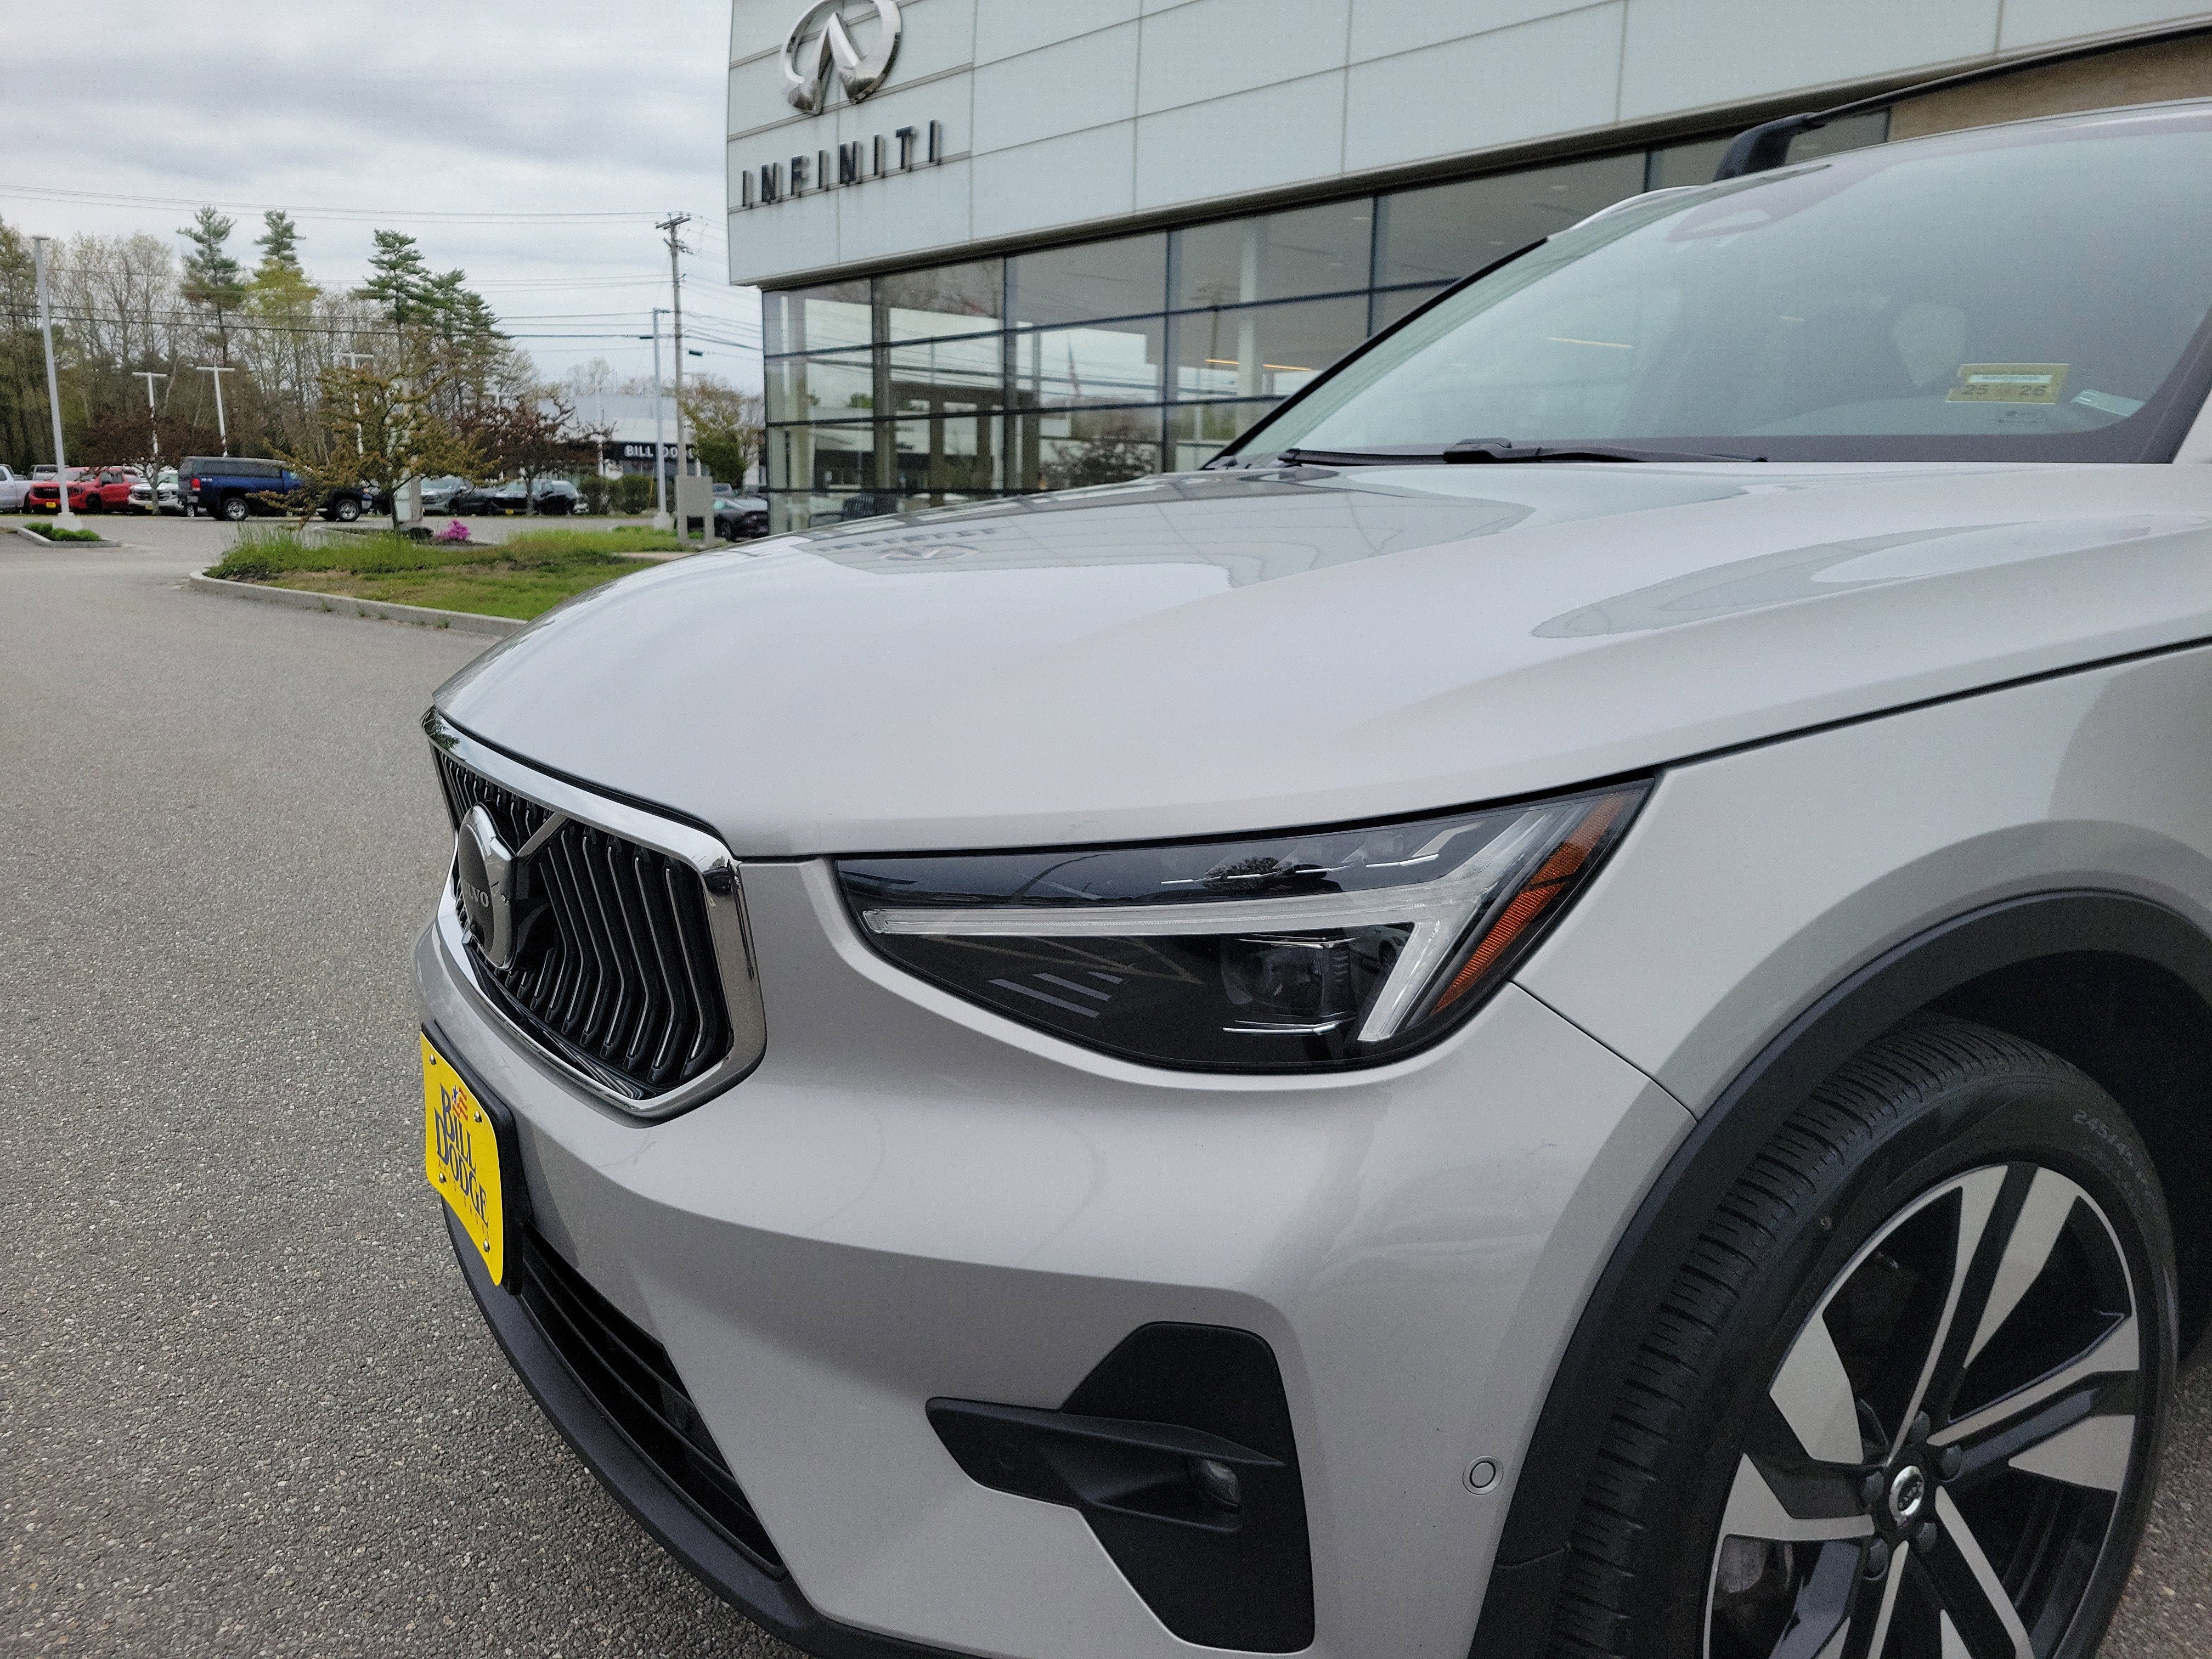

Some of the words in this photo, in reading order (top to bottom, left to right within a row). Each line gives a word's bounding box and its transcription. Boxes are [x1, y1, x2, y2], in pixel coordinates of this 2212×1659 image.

[742, 120, 941, 208] INFINITI
[1962, 384, 1989, 396] 25
[2019, 385, 2048, 397] 26
[624, 444, 654, 458] BILL
[434, 1106, 489, 1229] DODGE
[440, 1082, 476, 1175] BILL
